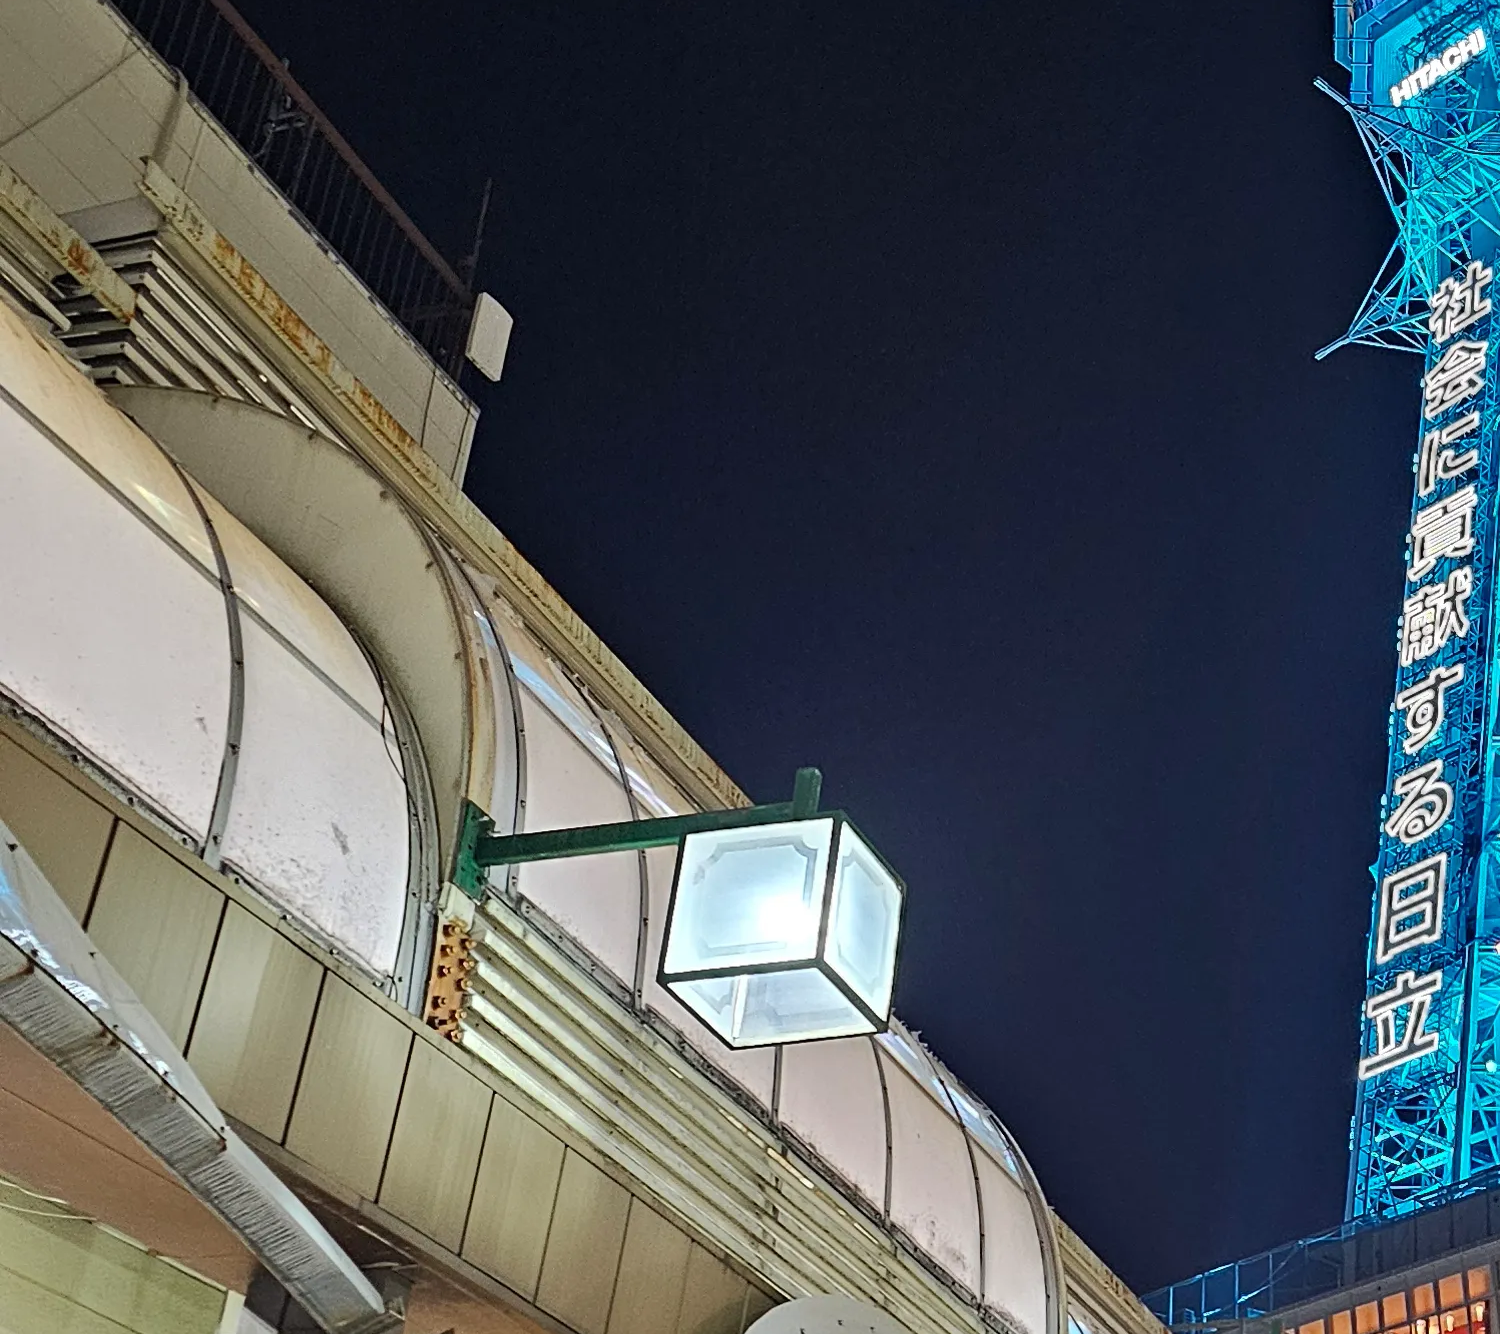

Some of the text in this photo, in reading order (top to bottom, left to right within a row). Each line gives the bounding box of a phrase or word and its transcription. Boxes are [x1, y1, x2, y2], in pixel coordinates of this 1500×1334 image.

[1389, 27, 1487, 108] HITACHI
[1358, 259, 1494, 1083] 社会に貢献する日立
